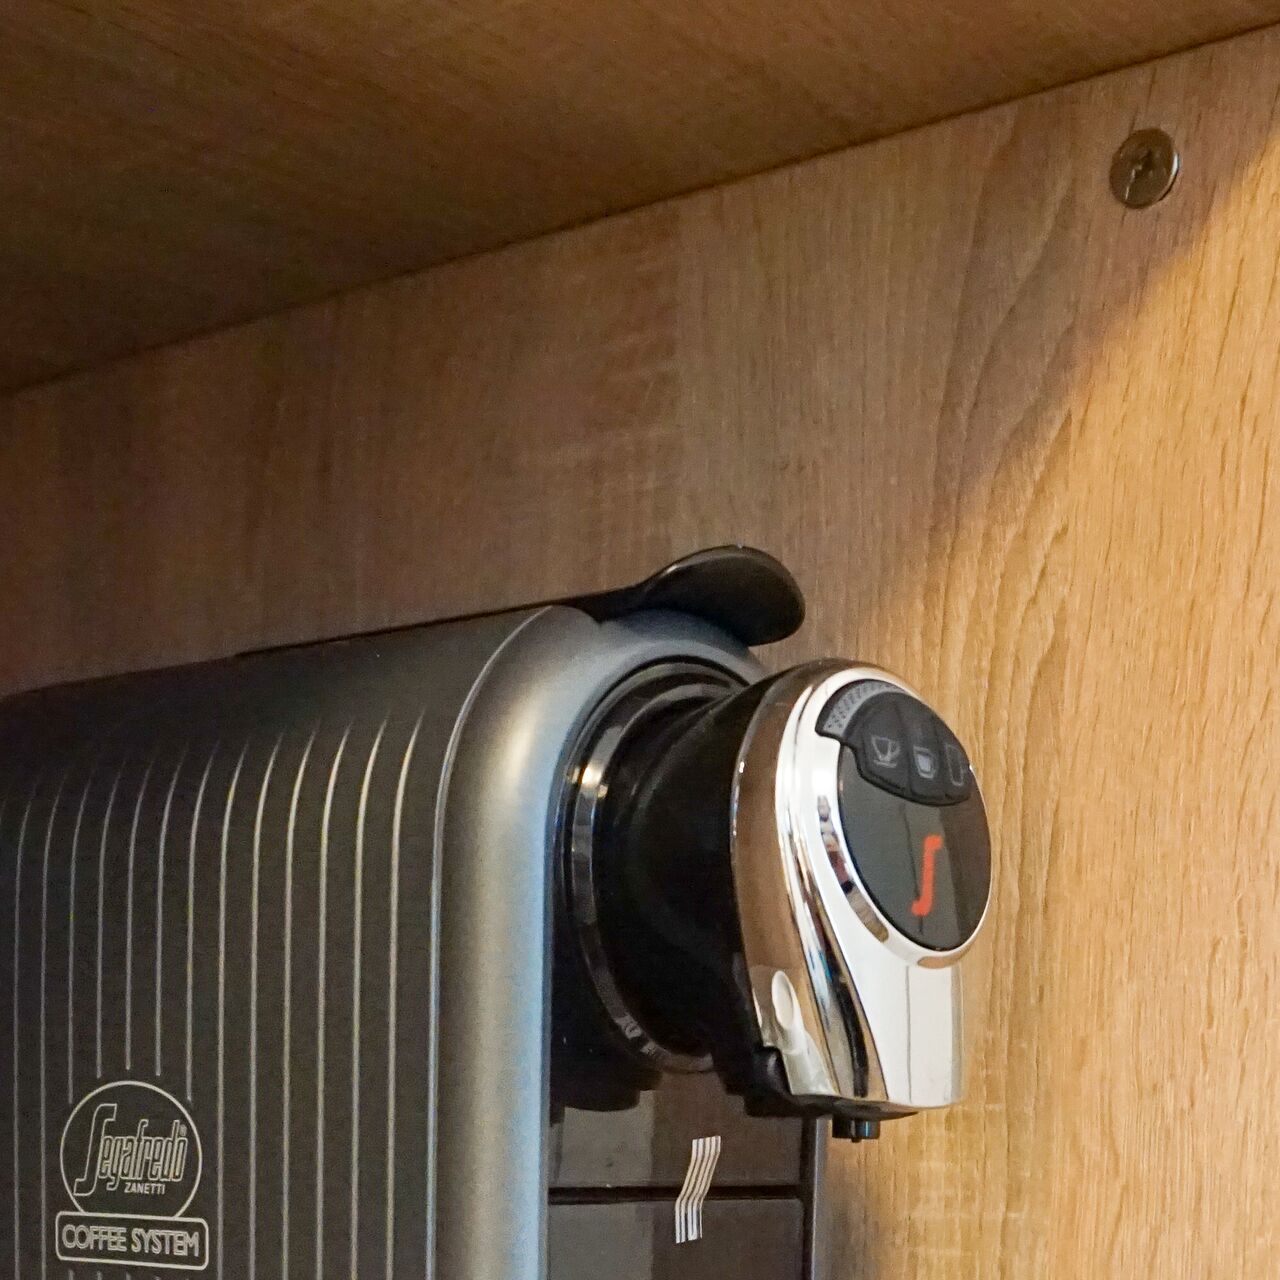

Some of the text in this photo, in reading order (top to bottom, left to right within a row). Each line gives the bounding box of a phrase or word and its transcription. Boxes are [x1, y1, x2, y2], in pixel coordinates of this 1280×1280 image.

[74, 1103, 188, 1196] Segafredo
[123, 1182, 166, 1195] ZANETTI
[62, 1224, 200, 1257] COFFEE SYSTEM
